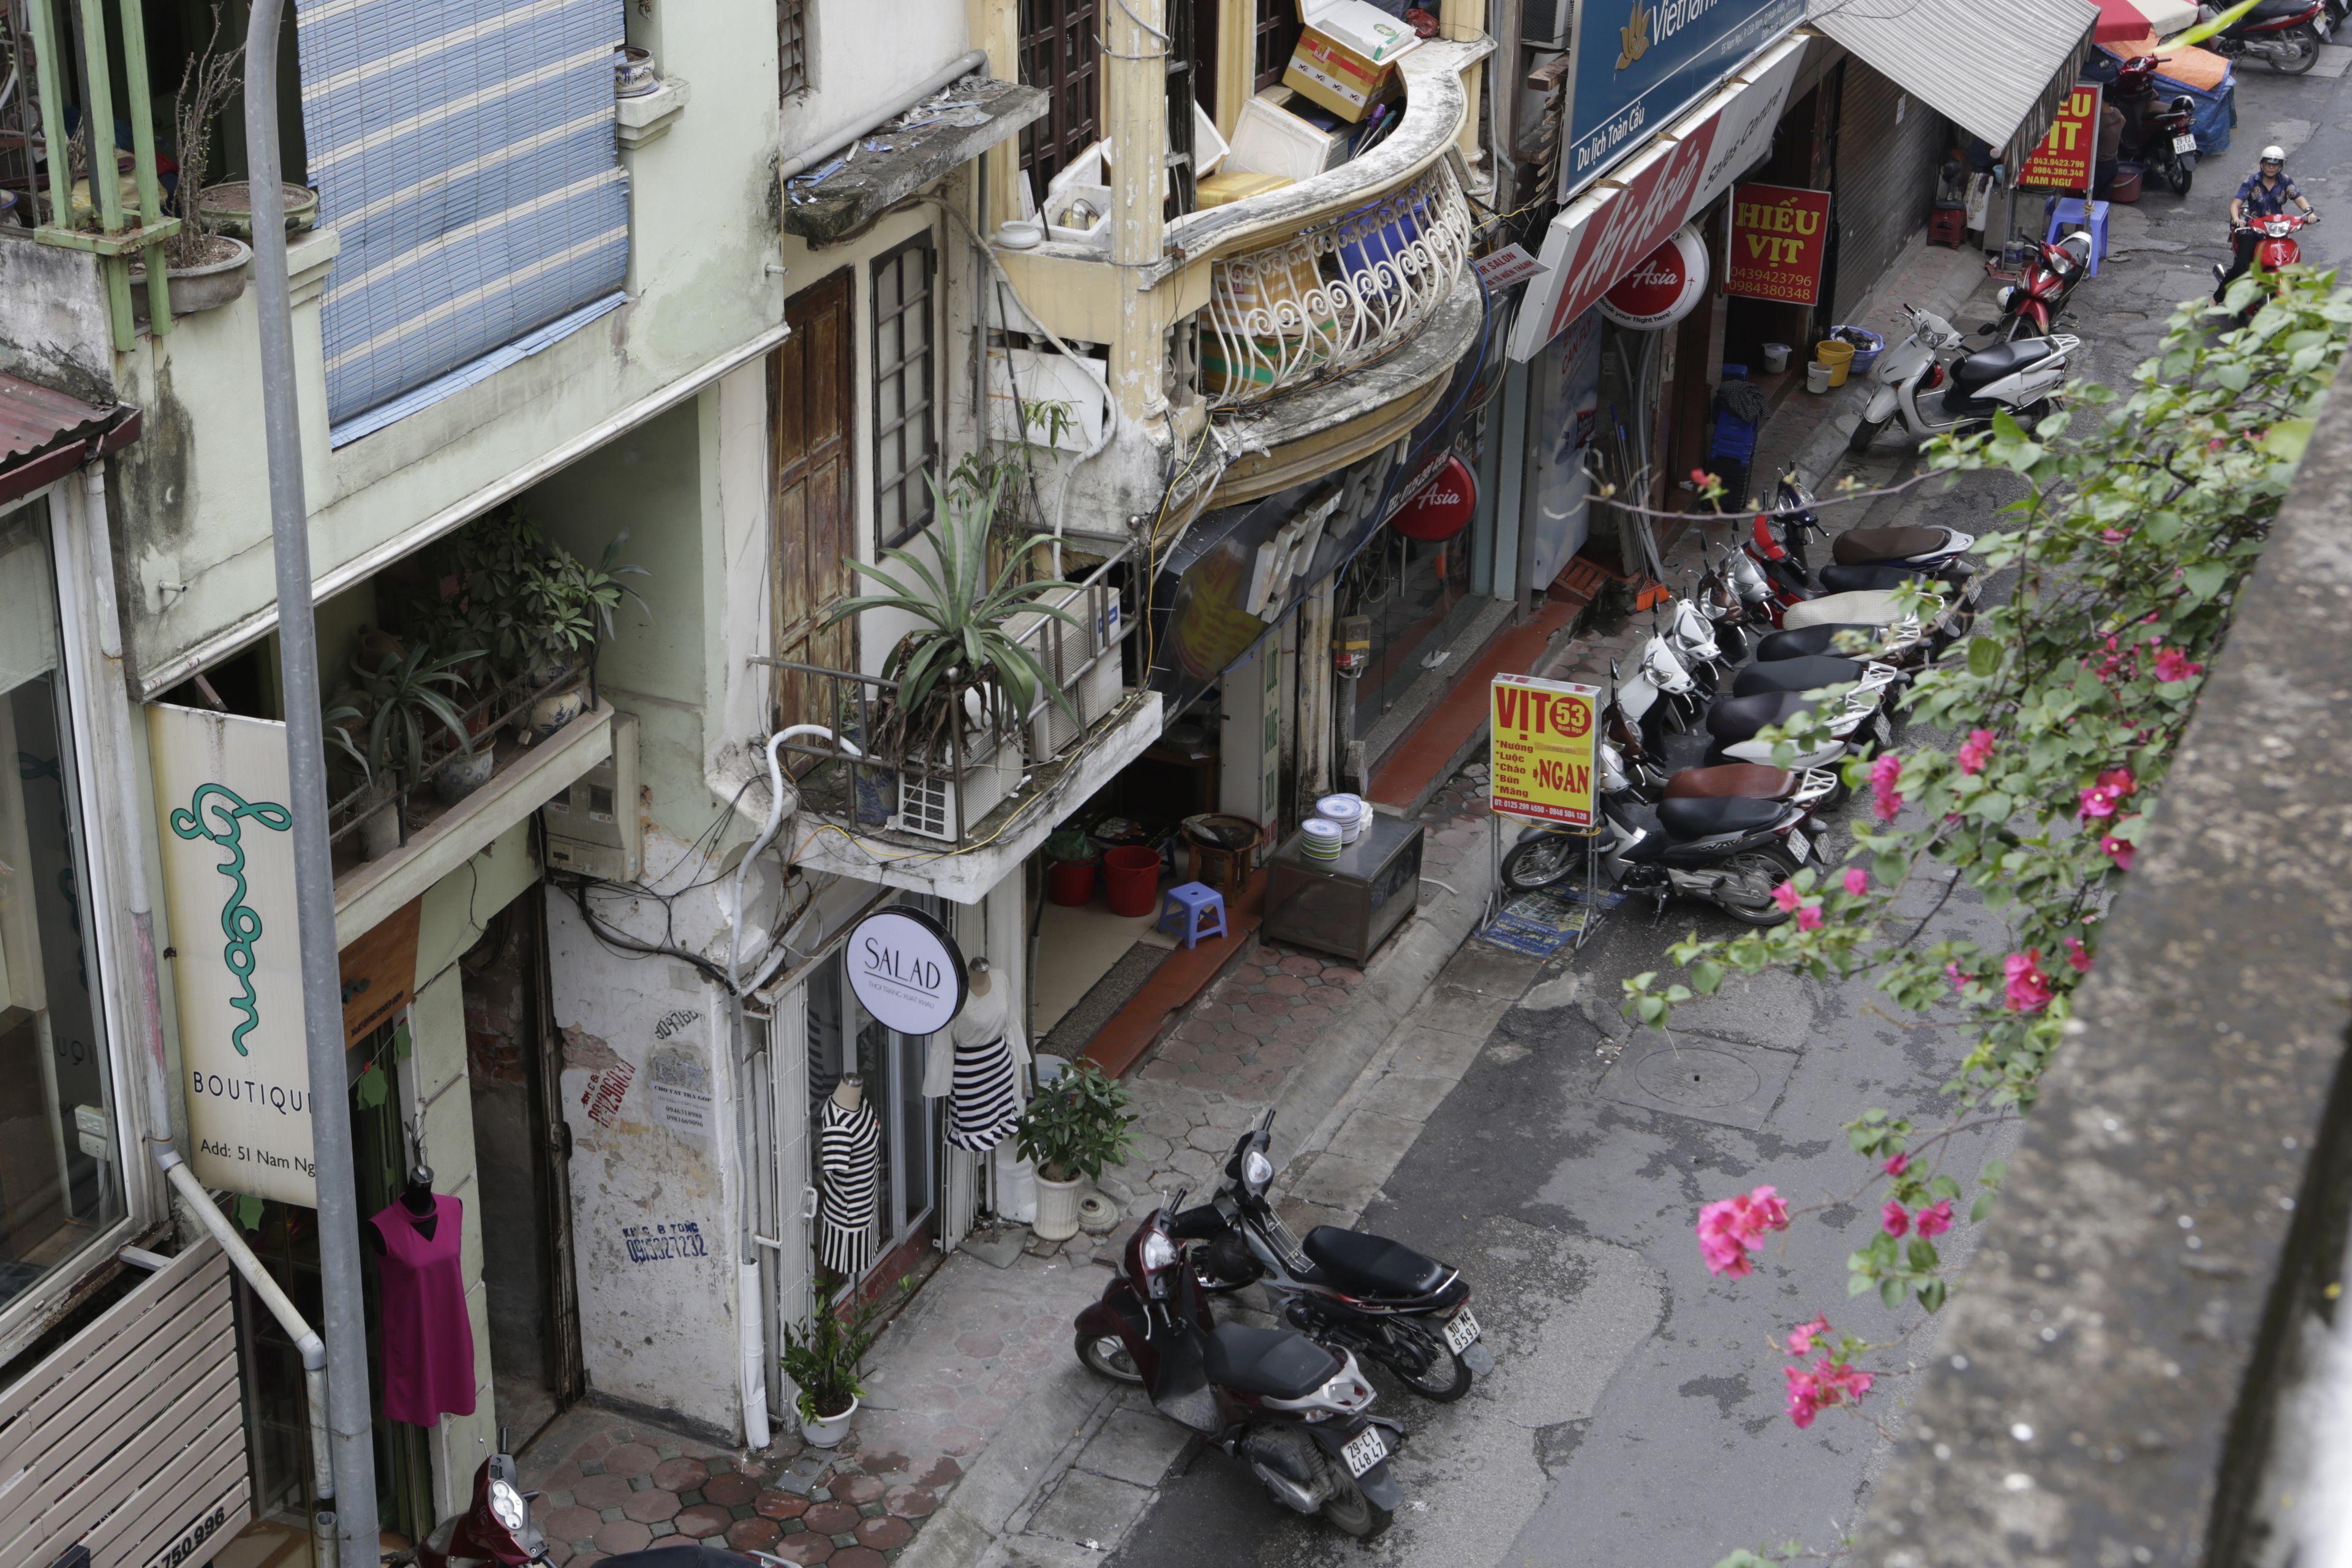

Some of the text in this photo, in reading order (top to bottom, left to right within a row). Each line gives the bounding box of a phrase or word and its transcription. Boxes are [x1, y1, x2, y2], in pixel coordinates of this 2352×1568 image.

[1577, 100, 1645, 172] Du lịch Toàn Cầu
[1704, 135, 1740, 192] Sales
[1741, 86, 1782, 146] Centre
[2033, 167, 2084, 177] 0984.380.348
[2034, 157, 2084, 168] 043.9423.796
[2026, 175, 2073, 187] NAM NGƯ
[1735, 197, 1820, 235] HIẾU
[1487, 252, 1517, 270] SALON
[1746, 234, 1804, 268] VỊT
[1730, 266, 1812, 287] 0439423796
[1728, 279, 1811, 300] 0984380348
[1599, 297, 1673, 324] Book your flight here!
[1495, 686, 1551, 741] VỊT
[1556, 703, 1585, 727] 53
[1500, 739, 1534, 753] Nướng
[1500, 752, 1525, 763] Luộc
[1500, 763, 1526, 774] Cháo
[1500, 774, 1520, 785] Bún
[1539, 758, 1590, 795] NGAN
[1500, 785, 1529, 798] Măng
[1504, 800, 1518, 809] 0125
[1530, 805, 1544, 813] 4550
[1549, 807, 1563, 816] 0948
[864, 937, 941, 989] SALAD
[194, 1071, 312, 1115] BOUTIQU
[669, 1088, 682, 1097] VAY
[666, 1106, 703, 1120] 0946318988
[201, 1139, 231, 1158] Add:
[238, 1145, 250, 1161] 51
[257, 1149, 290, 1169] Nam
[1455, 1323, 1478, 1349] 9593
[1348, 1431, 1376, 1459] 29-C1
[1352, 1442, 1384, 1473] 448.47
